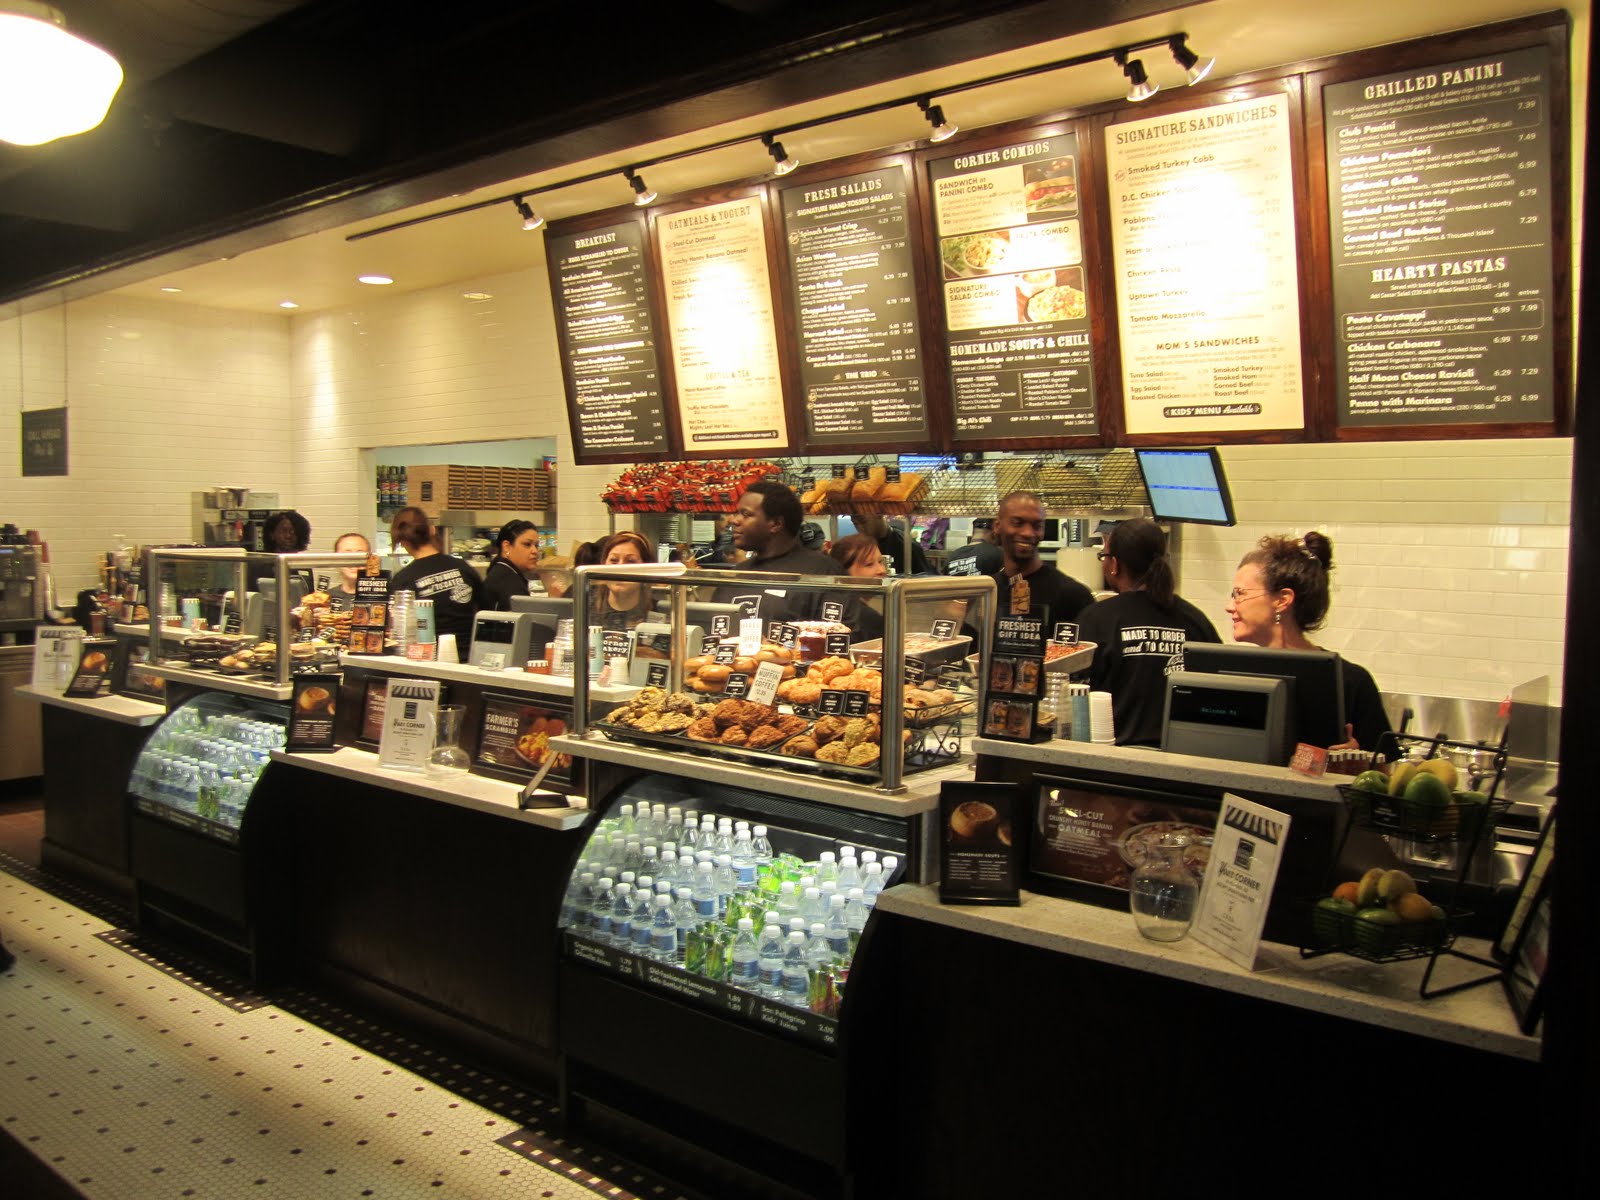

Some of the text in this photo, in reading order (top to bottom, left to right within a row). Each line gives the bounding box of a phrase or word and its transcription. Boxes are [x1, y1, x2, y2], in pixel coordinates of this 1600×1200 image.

[1364, 62, 1503, 100] GRILLED PANINI
[1116, 122, 1186, 145] SIGNATURE
[1190, 105, 1277, 132] SANDWICHES
[1339, 125, 1361, 138] Club
[1364, 121, 1396, 134] Panini
[1518, 133, 1536, 142] 7.49
[954, 142, 1050, 170] CORNER COMBOS
[1128, 154, 1215, 174] Smoked Turkey Cobb
[1518, 160, 1536, 169] 6.99
[939, 178, 978, 190] SANDWICH
[940, 183, 994, 198] PANINI COMBO
[804, 179, 882, 203] FRESH SALADS
[1122, 193, 1138, 202] D.C.
[797, 205, 828, 216] SIGNATURE
[870, 193, 893, 203] SALADS
[1409, 201, 1417, 211] &
[1418, 198, 1447, 209] Swiss
[1519, 189, 1537, 197] 6.79
[669, 214, 709, 230] OATMEALS
[712, 213, 716, 221] &
[719, 206, 751, 219] YOGURT
[1520, 216, 1538, 224] 7.29
[1041, 227, 1069, 236] COMBO
[575, 233, 616, 248] BREAKFAST
[1372, 257, 1505, 283] HEARTY PASTAS
[950, 292, 971, 301] SALAD
[1130, 310, 1206, 323] Tomato Mozzarella
[1347, 314, 1373, 324] Pesto
[1493, 306, 1510, 314] 6.99
[1520, 304, 1538, 312] 7.99
[950, 334, 1089, 356] HOMEMADE SOUPS & CHILI
[1156, 336, 1260, 350] MOM'S SANDWICHES
[1348, 334, 1538, 353] Chicken Carbonara 6.99 7.99
[1146, 370, 1164, 378] Salad
[1242, 365, 1263, 373] Turkey
[1349, 367, 1538, 384] Half Moon Cheese Ravioli 6.29 7.29
[1350, 394, 1538, 408] Penne with Marinara 6.29 6.99
[1171, 404, 1254, 416] KIDS' MENU Available
[999, 621, 1042, 632] FRESHEST
[1021, 632, 1041, 640] IDEA
[1121, 629, 1186, 641] MADE TO ORDER
[602, 639, 629, 647] orner
[1123, 642, 1143, 653] and
[1145, 641, 1156, 652] TO
[602, 646, 628, 654] akery
[758, 670, 780, 681] MUFFIN
[755, 680, 776, 691] COFFEE
[485, 713, 520, 728] FARMER'S
[484, 724, 519, 735] SCRAMBLER
[1057, 823, 1102, 839] OATMEAL
[1234, 872, 1261, 891] CORNER
[818, 1024, 834, 1034] 2.09
